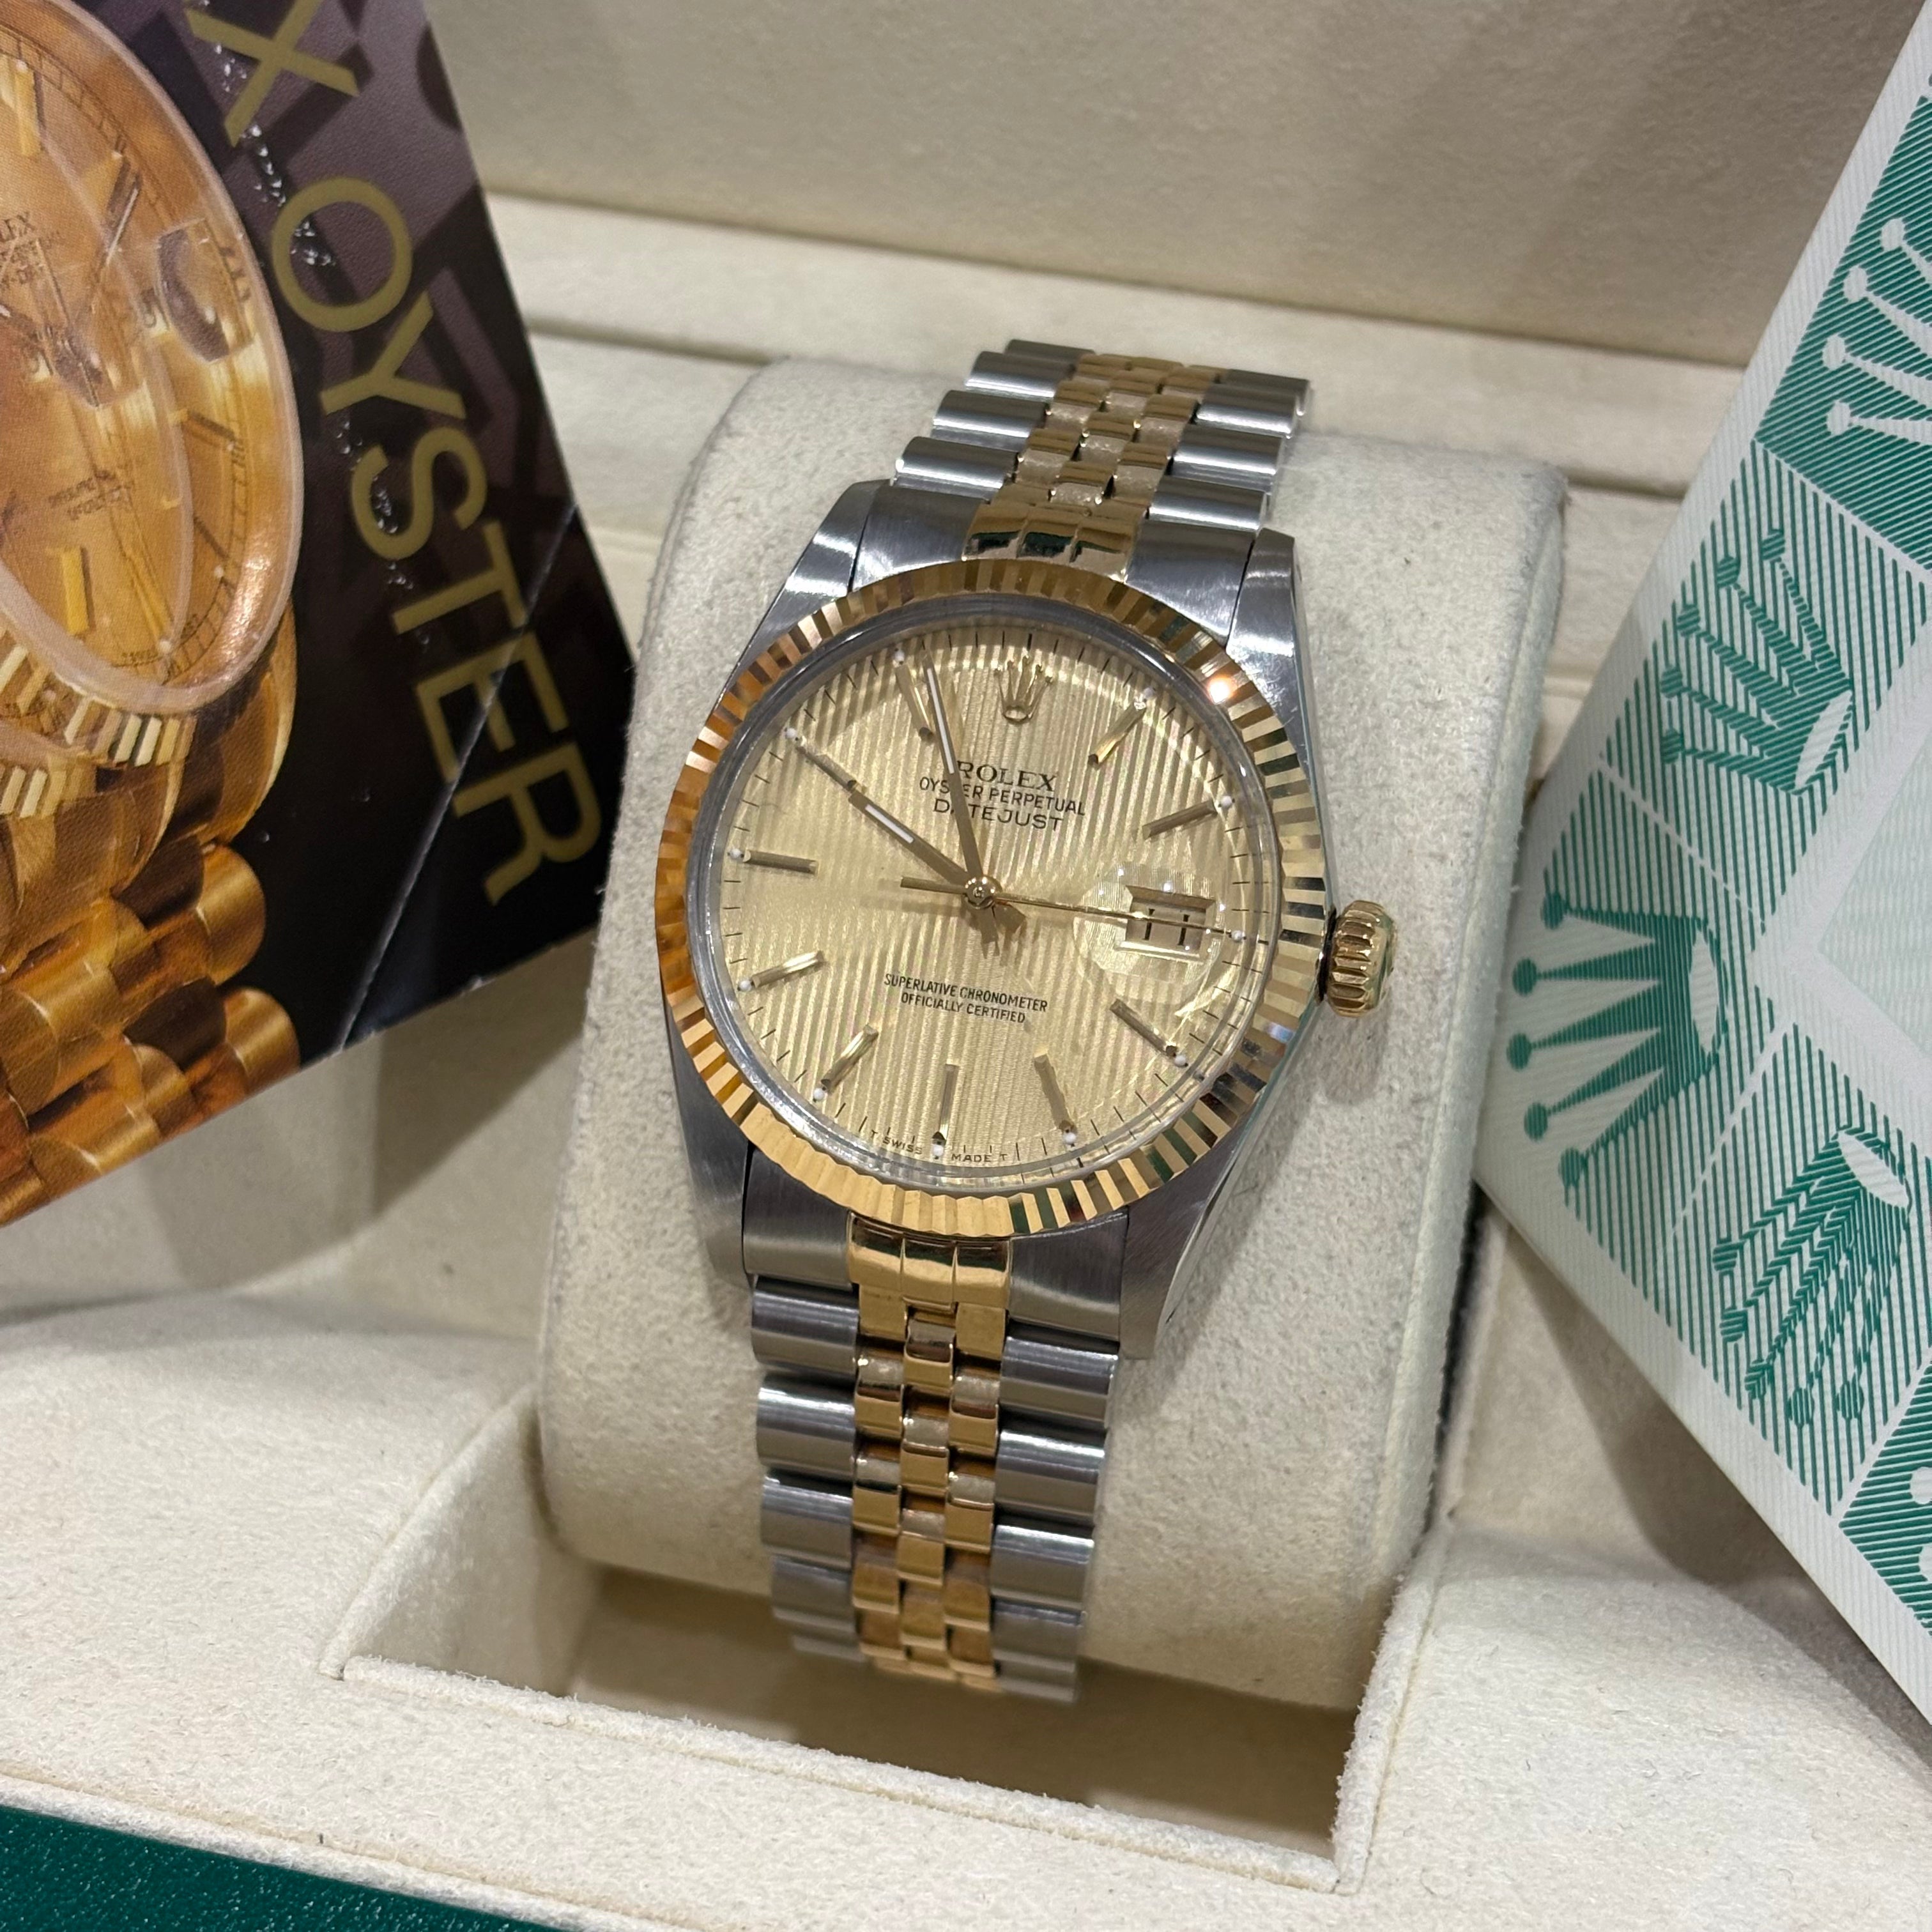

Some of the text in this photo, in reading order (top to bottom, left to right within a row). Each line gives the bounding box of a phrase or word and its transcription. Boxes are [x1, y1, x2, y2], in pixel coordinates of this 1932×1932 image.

[272, 176, 602, 905] OYSTER
[957, 760, 1057, 792] ROLEX
[919, 776, 1085, 816] OYSER PERPETUAL
[933, 797, 1063, 831] DTEJUST
[884, 972, 1048, 1012] SUPERLATIVE CHRONOMETER
[901, 992, 1026, 1023] OFFICIALLY CERTIFIED
[882, 1137, 923, 1155] SWISS
[951, 1153, 992, 1163] MADE
